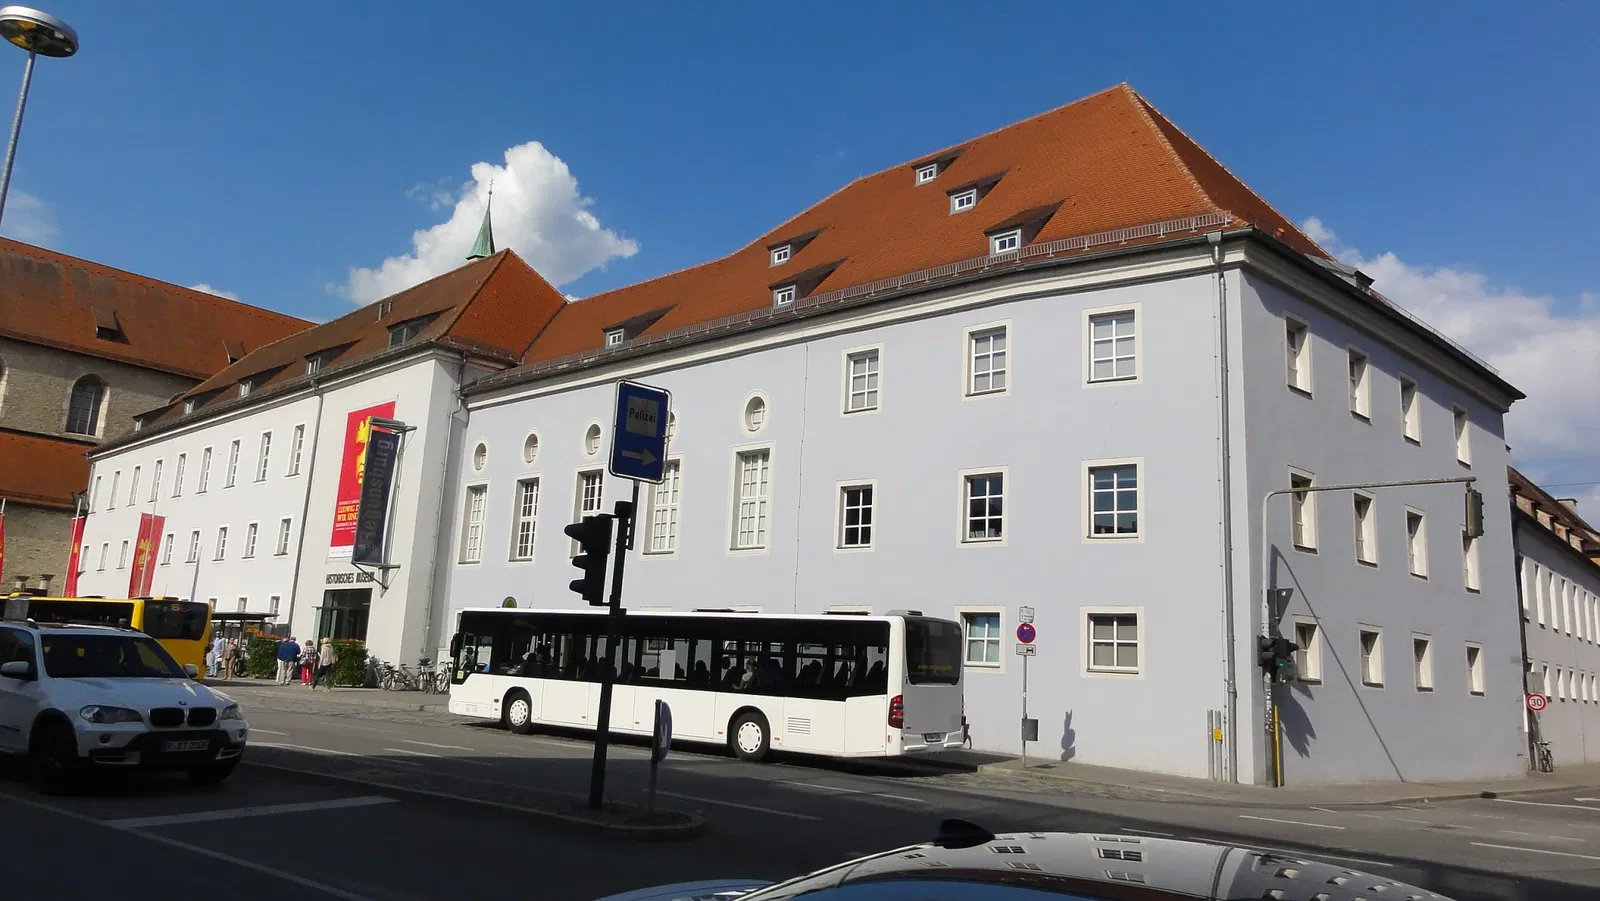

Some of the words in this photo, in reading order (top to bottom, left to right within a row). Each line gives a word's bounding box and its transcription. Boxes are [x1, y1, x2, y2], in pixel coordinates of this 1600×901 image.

[629, 408, 656, 423] Polizei
[359, 439, 395, 545] Regensburg
[325, 573, 354, 585] HISTORISCHES
[355, 571, 375, 583] MUSEUM
[1530, 698, 1542, 706] 30
